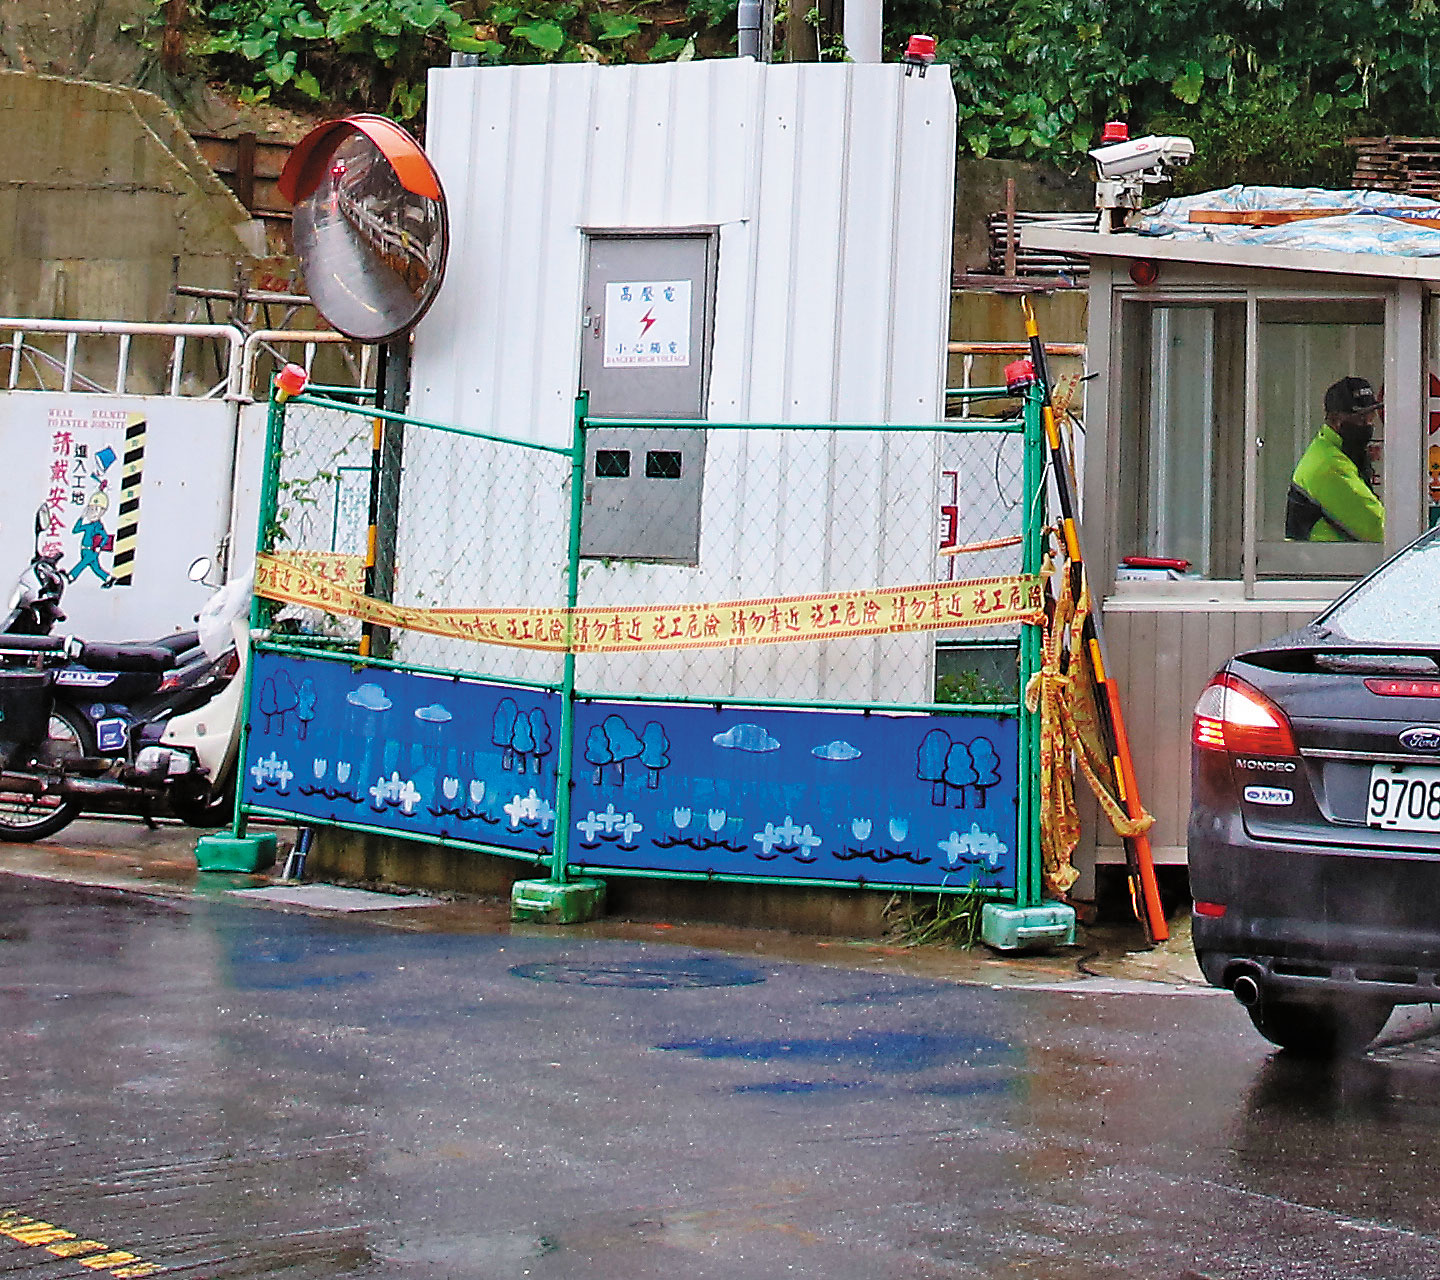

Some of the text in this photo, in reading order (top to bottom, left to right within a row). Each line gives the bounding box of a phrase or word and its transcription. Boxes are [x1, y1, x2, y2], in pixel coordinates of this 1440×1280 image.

[620, 286, 676, 302] 高壓電
[615, 341, 678, 354] 小心觸電
[70, 443, 88, 506] 進入工地
[573, 615, 644, 643] 請勿靠近
[653, 613, 721, 640] 施工危險
[729, 605, 801, 637] 請勿靠近
[810, 600, 881, 629] 施工危險
[891, 591, 963, 624] 請勿靠近
[973, 585, 1042, 614] 施工危險
[1410, 733, 1440, 748] Ford
[1235, 758, 1296, 773] MONDEO
